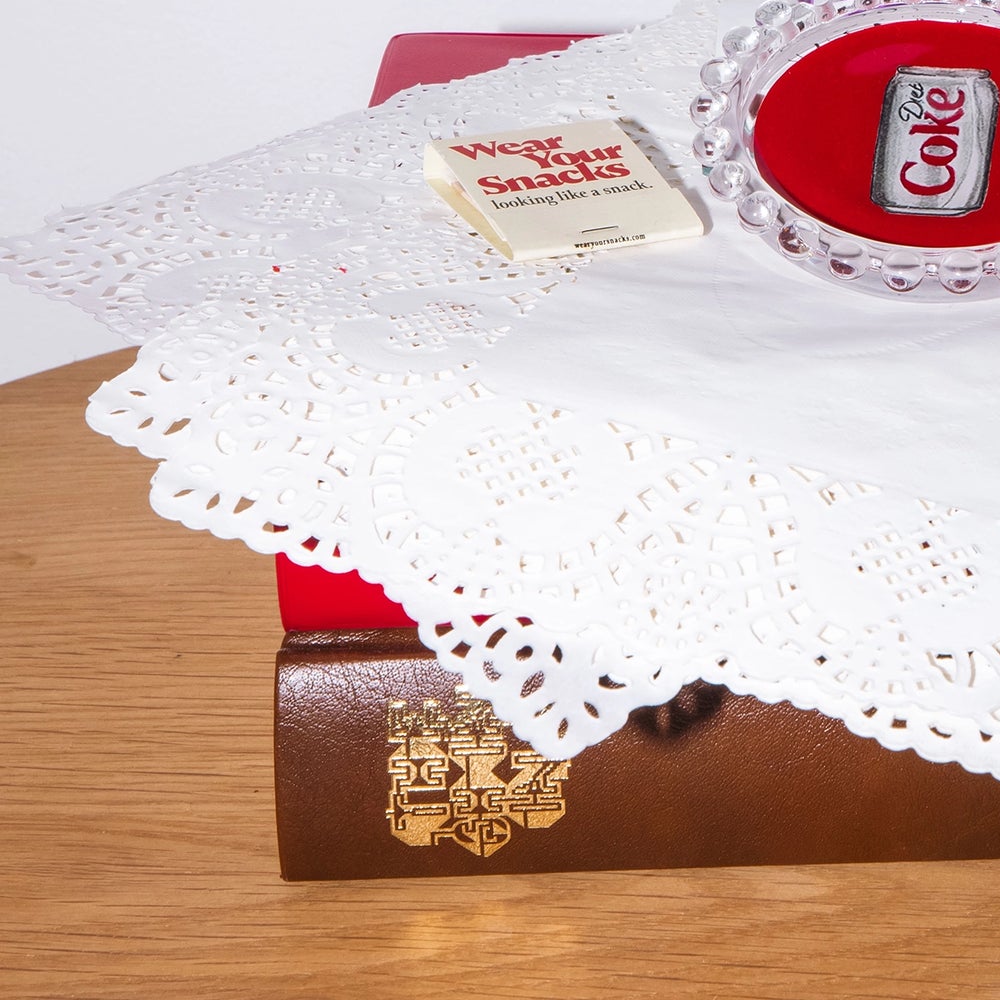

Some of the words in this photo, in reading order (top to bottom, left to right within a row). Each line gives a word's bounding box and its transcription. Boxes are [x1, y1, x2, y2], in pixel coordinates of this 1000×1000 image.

[898, 82, 925, 122] Diet
[449, 135, 564, 161] Wear
[521, 144, 624, 169] Your
[900, 87, 966, 196] Coke
[477, 162, 631, 196] Snacks
[491, 193, 558, 210] looking
[555, 188, 588, 202] like
[592, 188, 601, 197] a
[604, 179, 654, 195] snack.
[574, 233, 647, 250] wearyoursnacks.com
